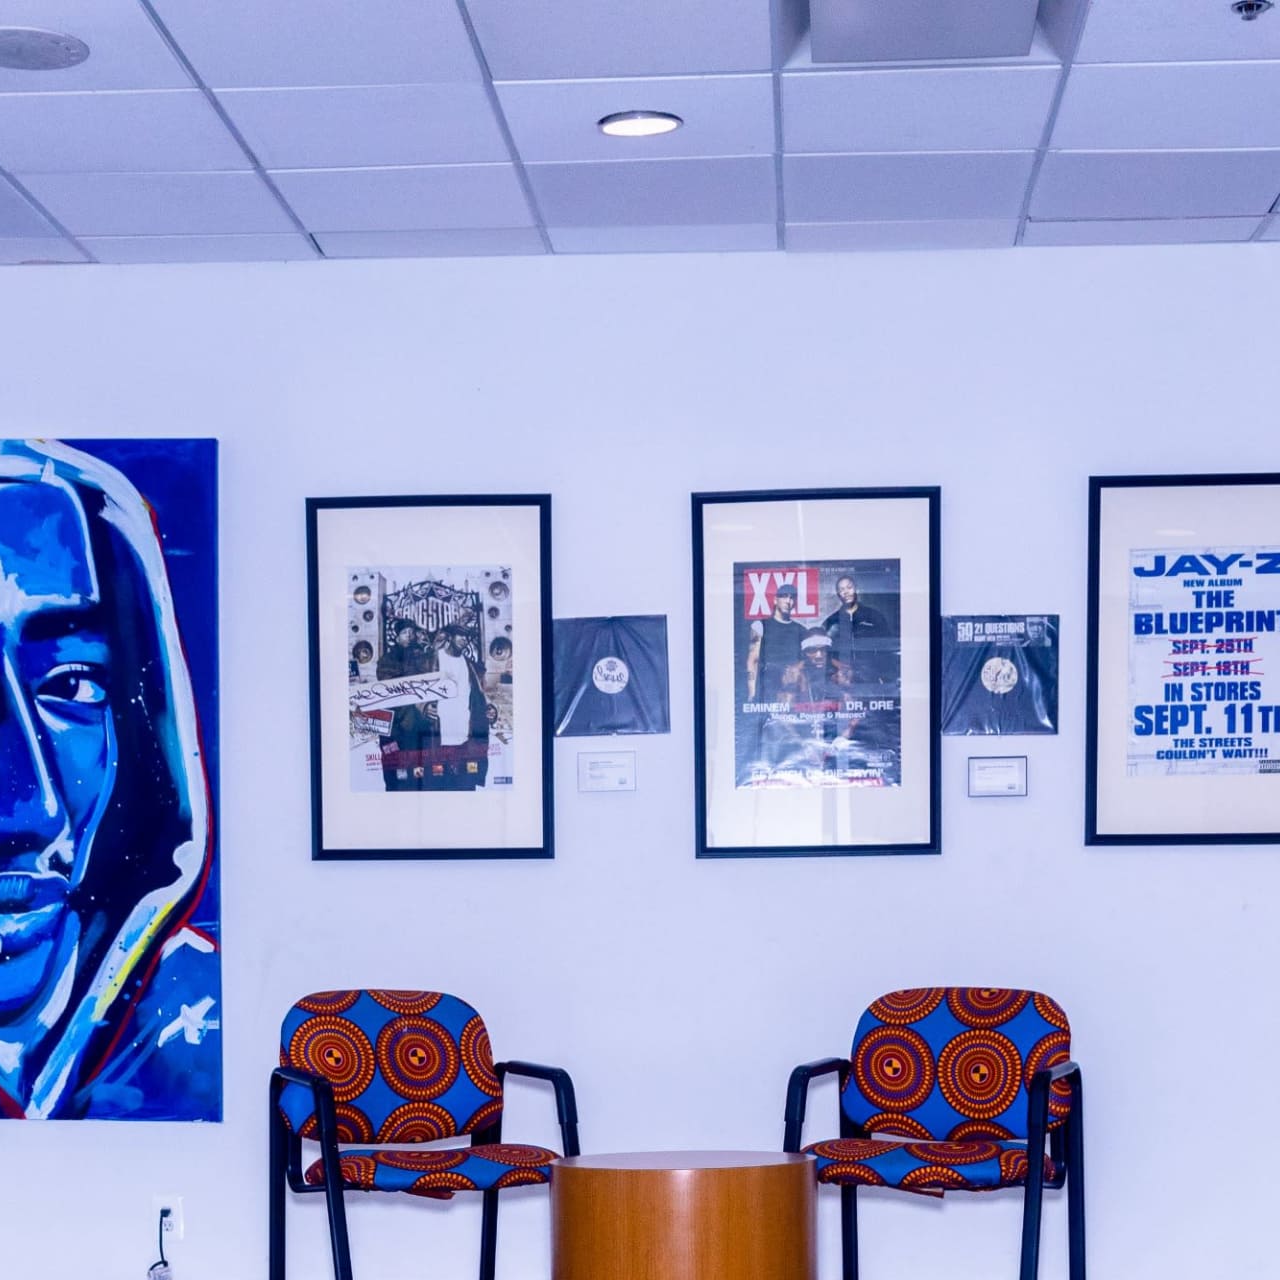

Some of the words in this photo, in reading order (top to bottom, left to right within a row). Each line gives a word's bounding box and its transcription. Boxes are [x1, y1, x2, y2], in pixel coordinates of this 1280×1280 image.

[1183, 579, 1204, 588] NEW
[1208, 578, 1243, 587] ALBUM
[748, 571, 816, 616] XXL
[1192, 590, 1235, 609] THE
[985, 622, 1025, 634] QUESTIONS
[1172, 639, 1210, 655] SEPT.
[1173, 661, 1210, 677] SEPT.
[1164, 682, 1183, 702] IN
[1190, 681, 1261, 702] STORES
[742, 702, 790, 713] EMINEM
[846, 701, 867, 711] DR.
[869, 700, 895, 710] DRE
[1133, 703, 1212, 736] SEPT.
[1173, 737, 1195, 748] THE
[1198, 737, 1252, 748] STREETS
[1156, 748, 1217, 760] COULDN'T
[1222, 748, 1269, 759] WAIT!!!
